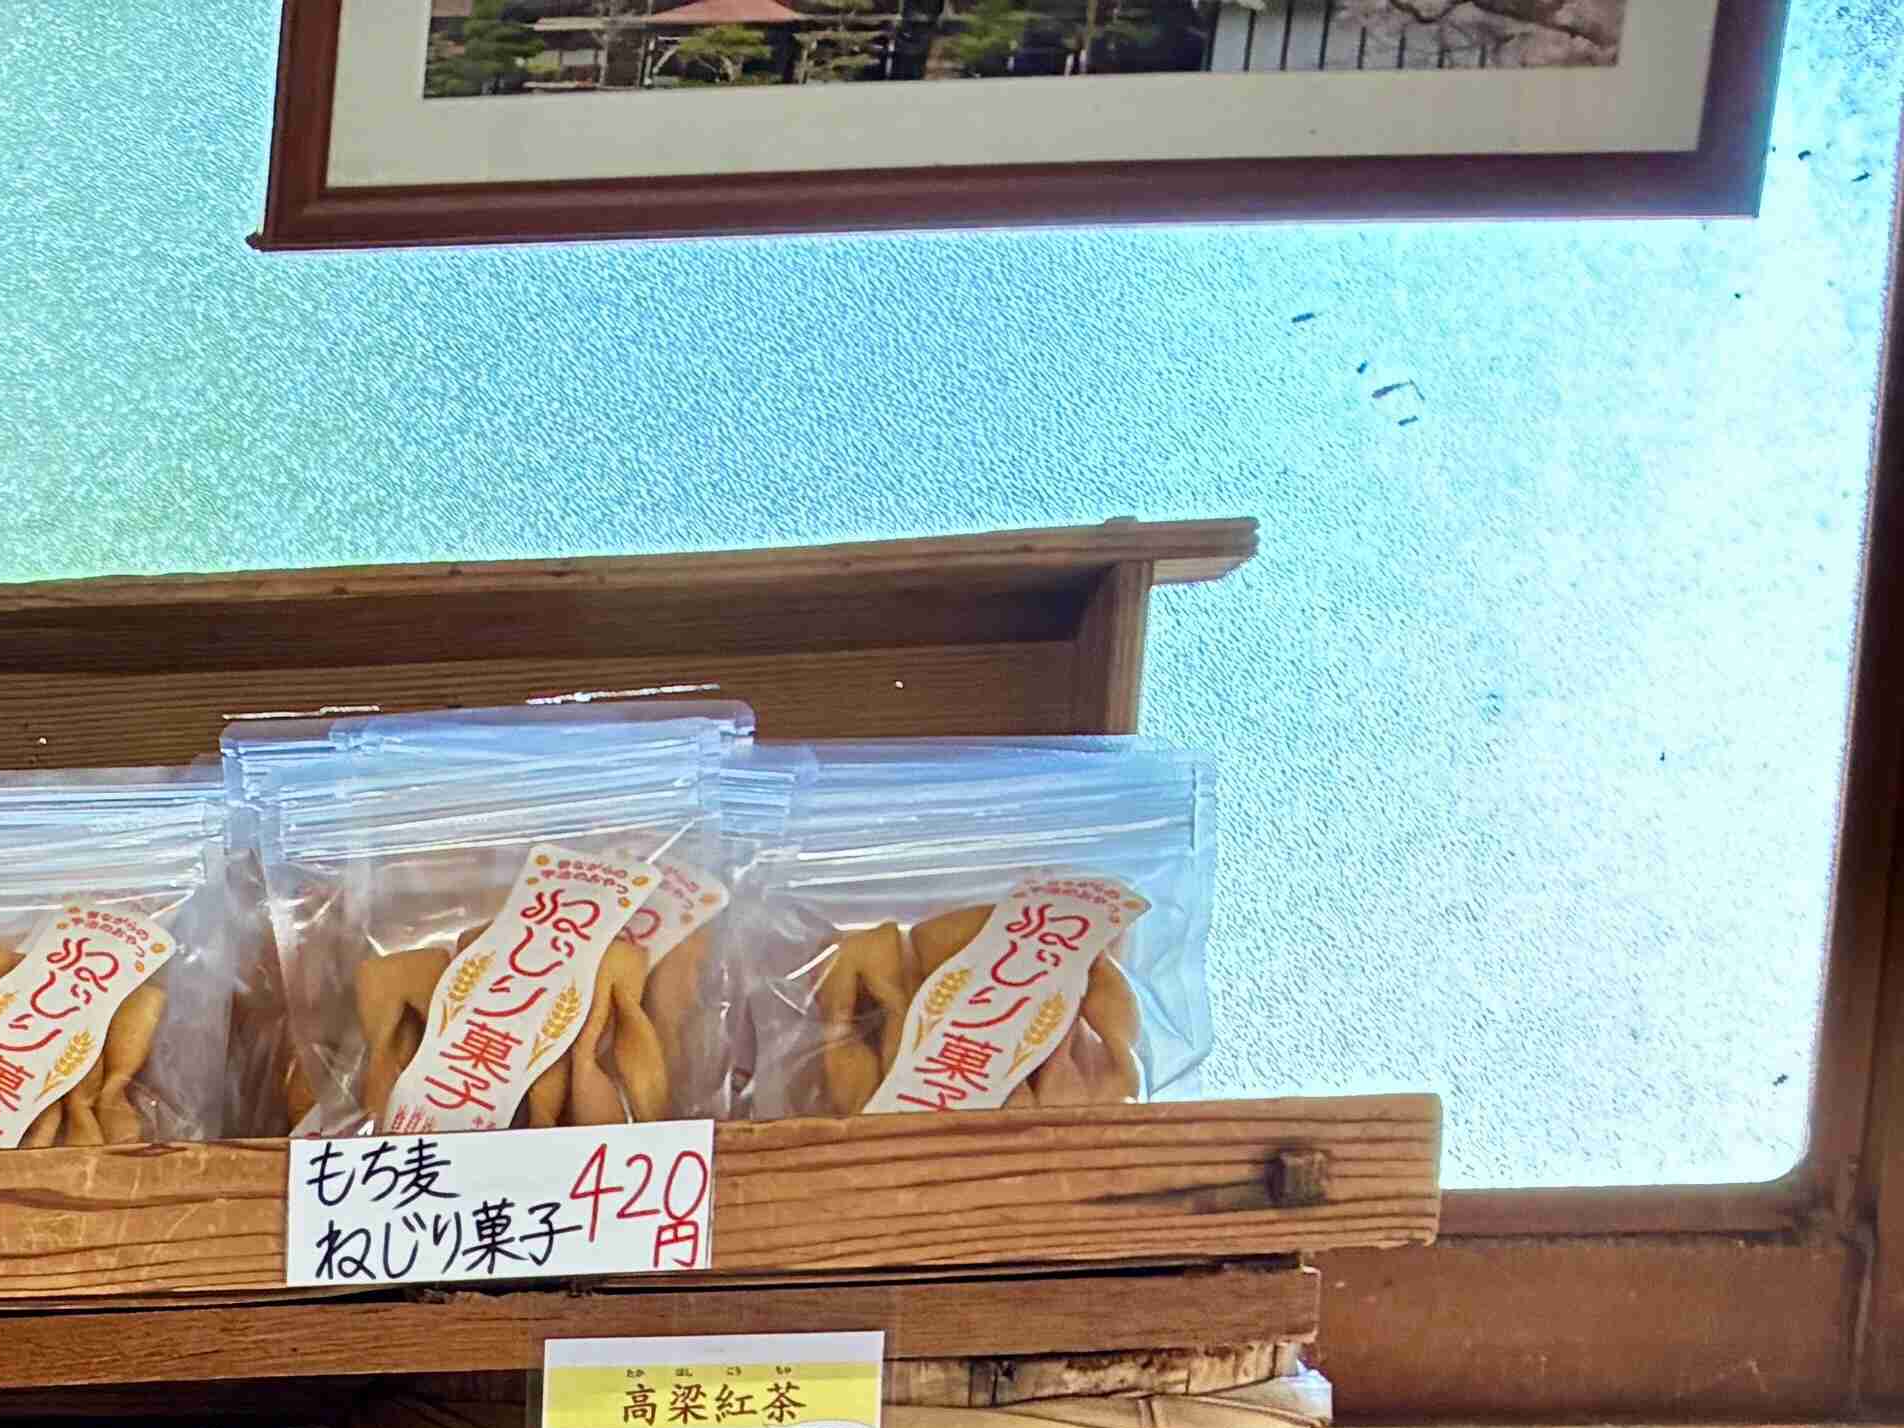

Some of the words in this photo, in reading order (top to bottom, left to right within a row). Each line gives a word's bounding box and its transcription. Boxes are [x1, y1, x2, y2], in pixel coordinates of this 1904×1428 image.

[424, 888, 601, 1112] ねじり菓子
[305, 1137, 460, 1208] もち麦
[314, 1198, 584, 1281] ねじり菓子
[569, 1143, 709, 1269] 420円
[622, 1380, 808, 1427] 高梁紅茶
